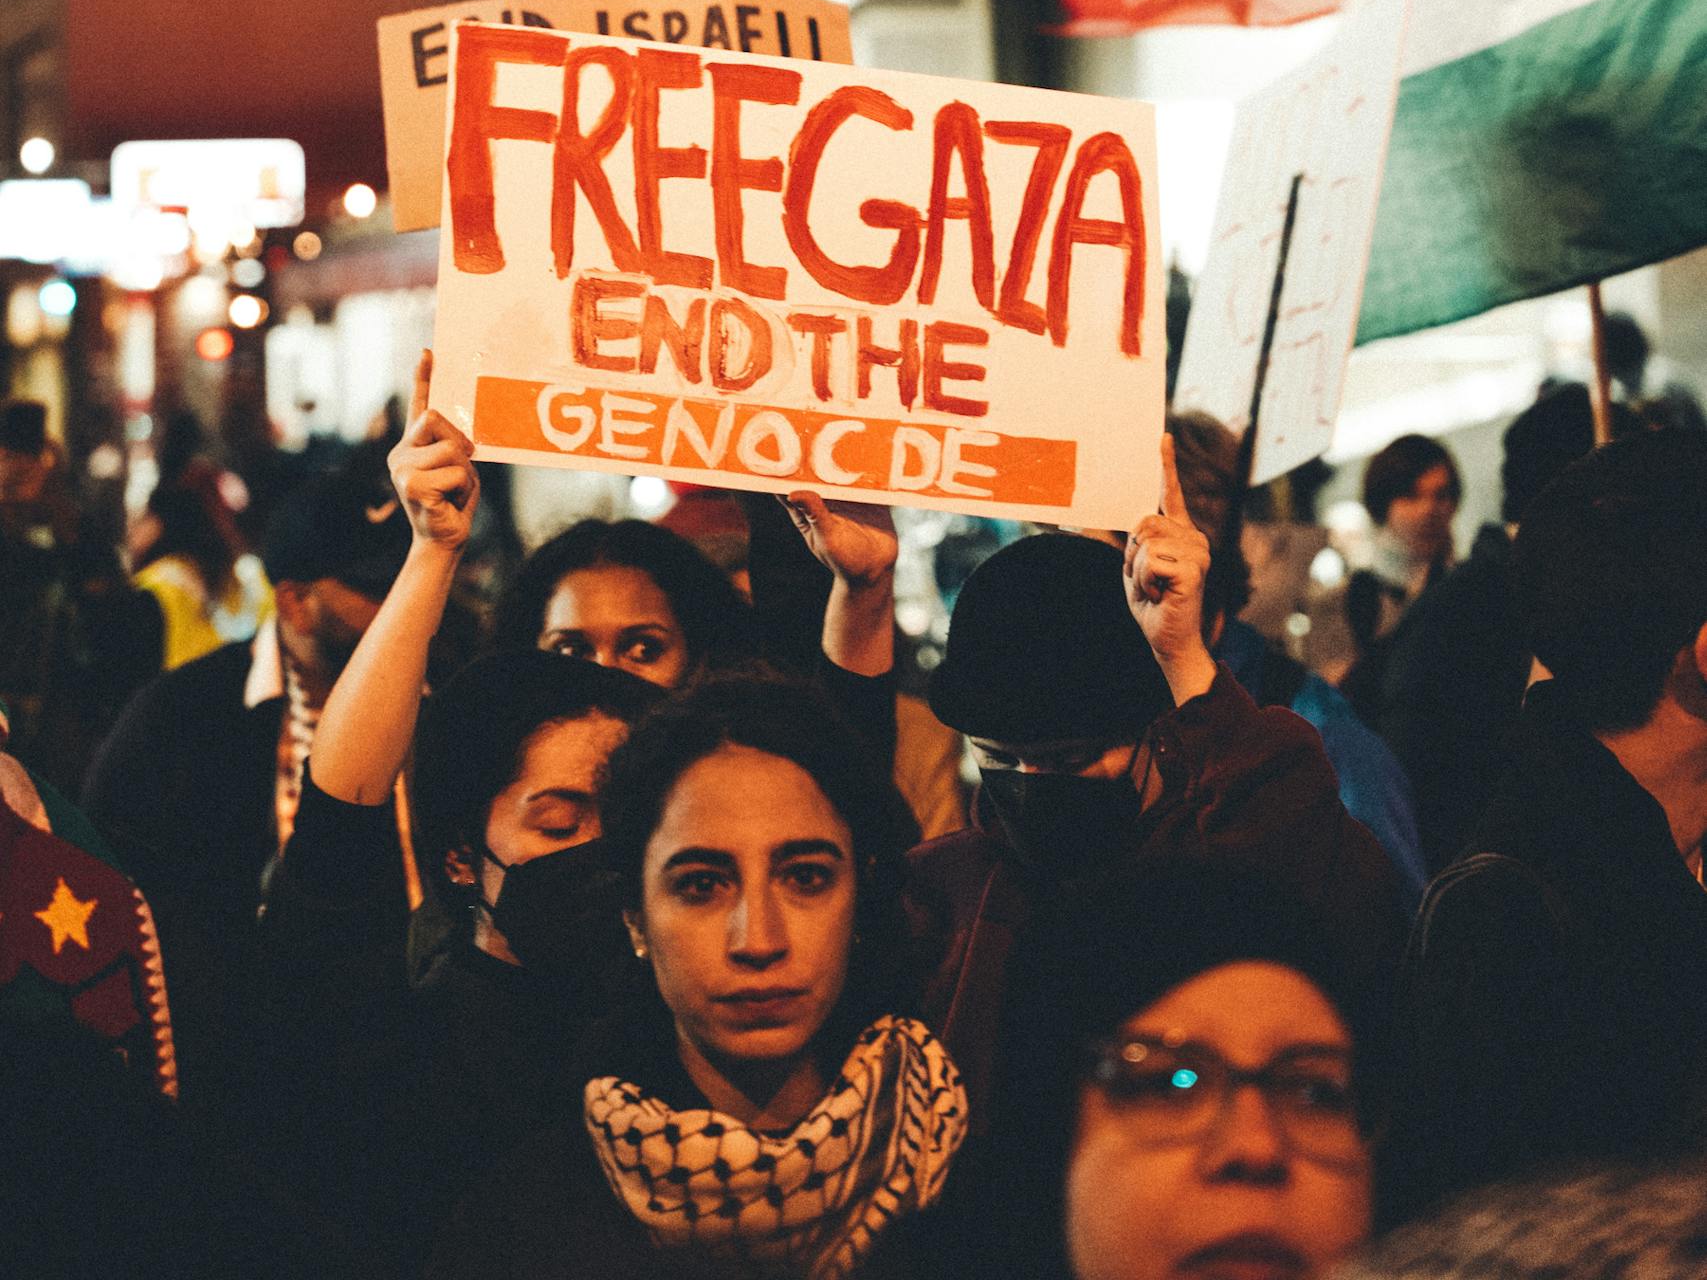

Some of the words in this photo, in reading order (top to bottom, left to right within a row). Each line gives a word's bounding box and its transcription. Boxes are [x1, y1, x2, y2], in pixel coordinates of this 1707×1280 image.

[448, 25, 802, 301] FREE
[784, 85, 1147, 359] GAZA
[572, 273, 773, 393] END
[787, 314, 990, 417] THE
